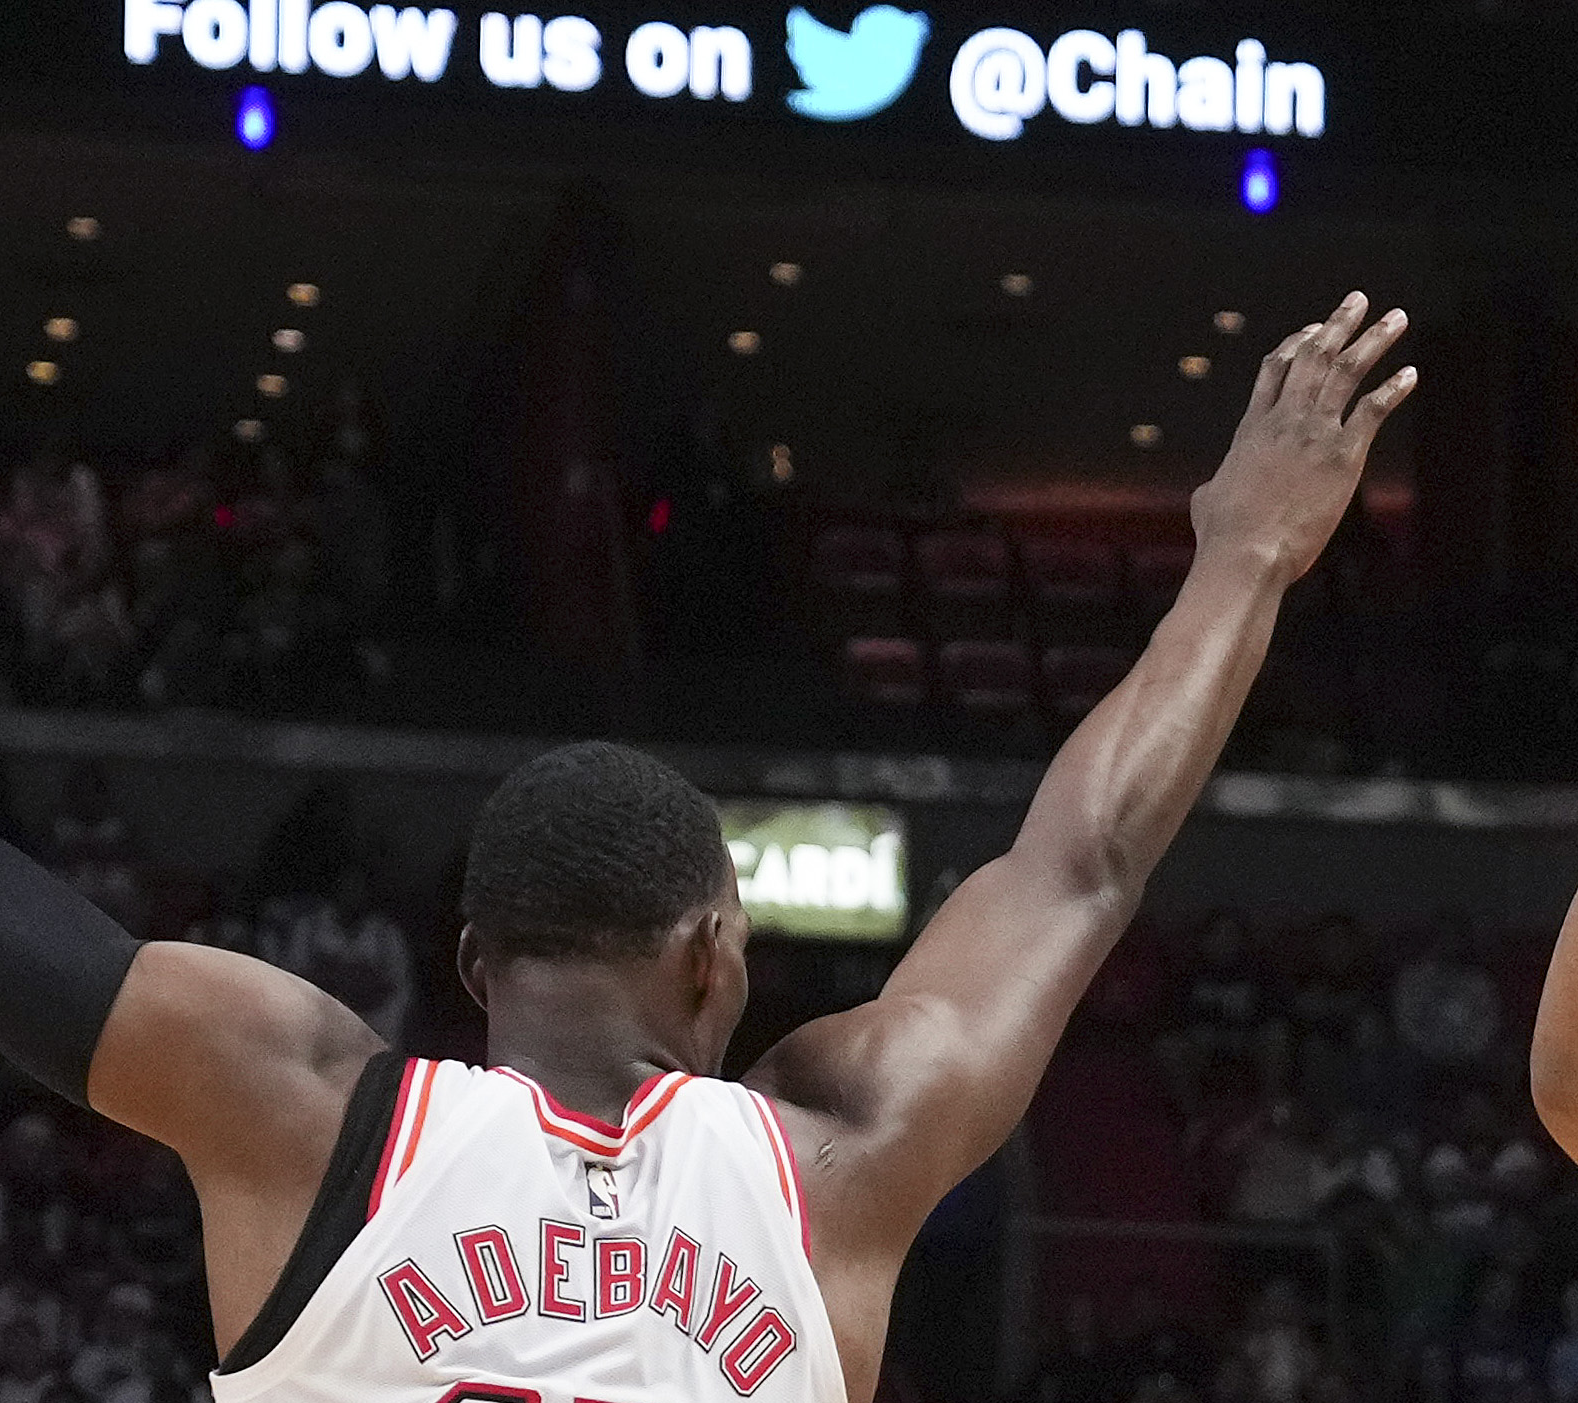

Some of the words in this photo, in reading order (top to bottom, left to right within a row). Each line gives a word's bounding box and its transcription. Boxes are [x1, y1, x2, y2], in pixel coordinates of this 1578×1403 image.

[123, 0, 458, 83] Follow
[479, 11, 603, 92] us
[625, 21, 752, 101] on
[949, 26, 1325, 141] @Chain
[378, 1217, 798, 1398] ADEBAYO
